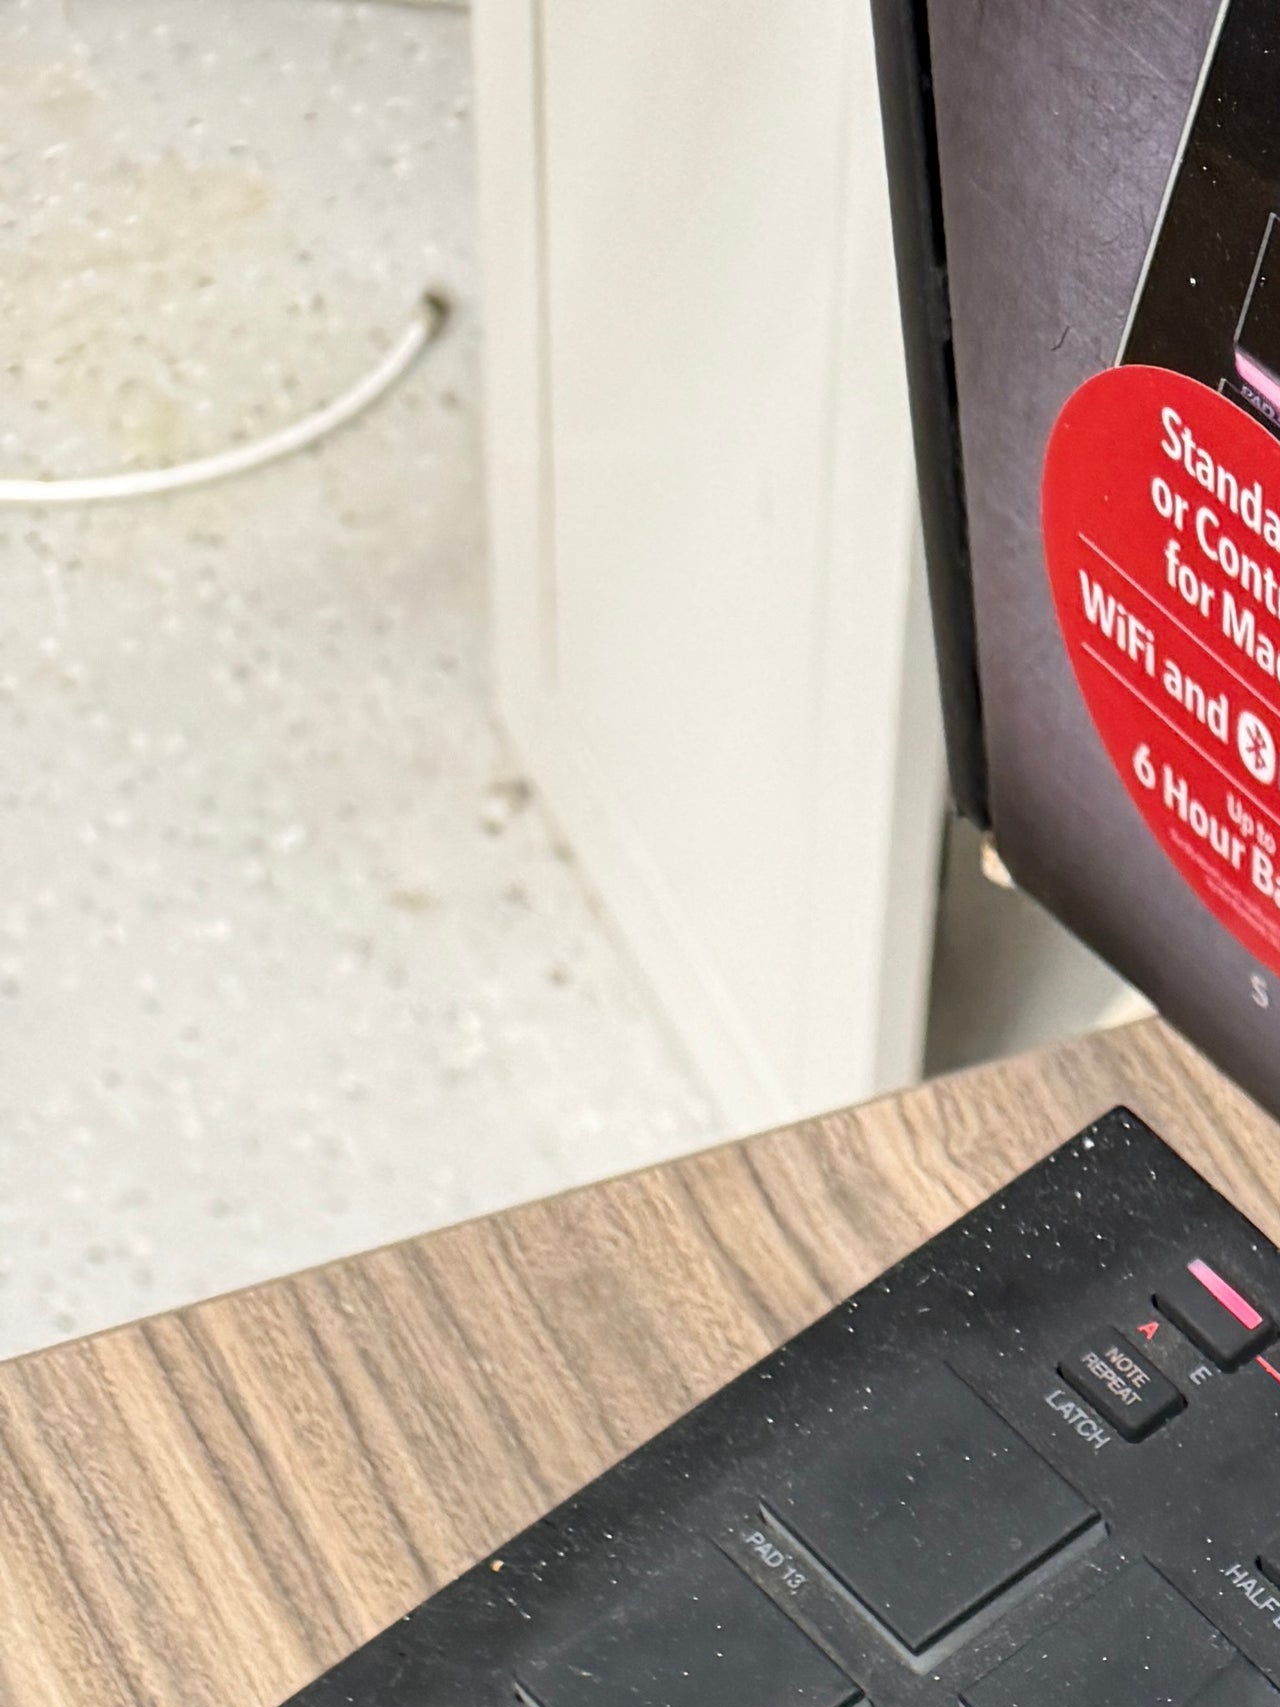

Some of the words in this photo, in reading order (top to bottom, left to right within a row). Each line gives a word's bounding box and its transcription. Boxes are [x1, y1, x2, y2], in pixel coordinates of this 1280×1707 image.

[1151, 477, 1188, 530] or
[1164, 539, 1215, 618] for
[1079, 570, 1156, 677] WiFi
[1163, 659, 1229, 745] and
[1132, 743, 1156, 790] 6
[1163, 764, 1245, 871] Hour
[1226, 793, 1256, 838] Up
[1256, 825, 1277, 856] to
[1080, 1351, 1141, 1407] REPEAT
[1105, 1345, 1151, 1389] NOTE
[1045, 1389, 1112, 1450] LATCH
[1225, 1563, 1280, 1615] HALF
